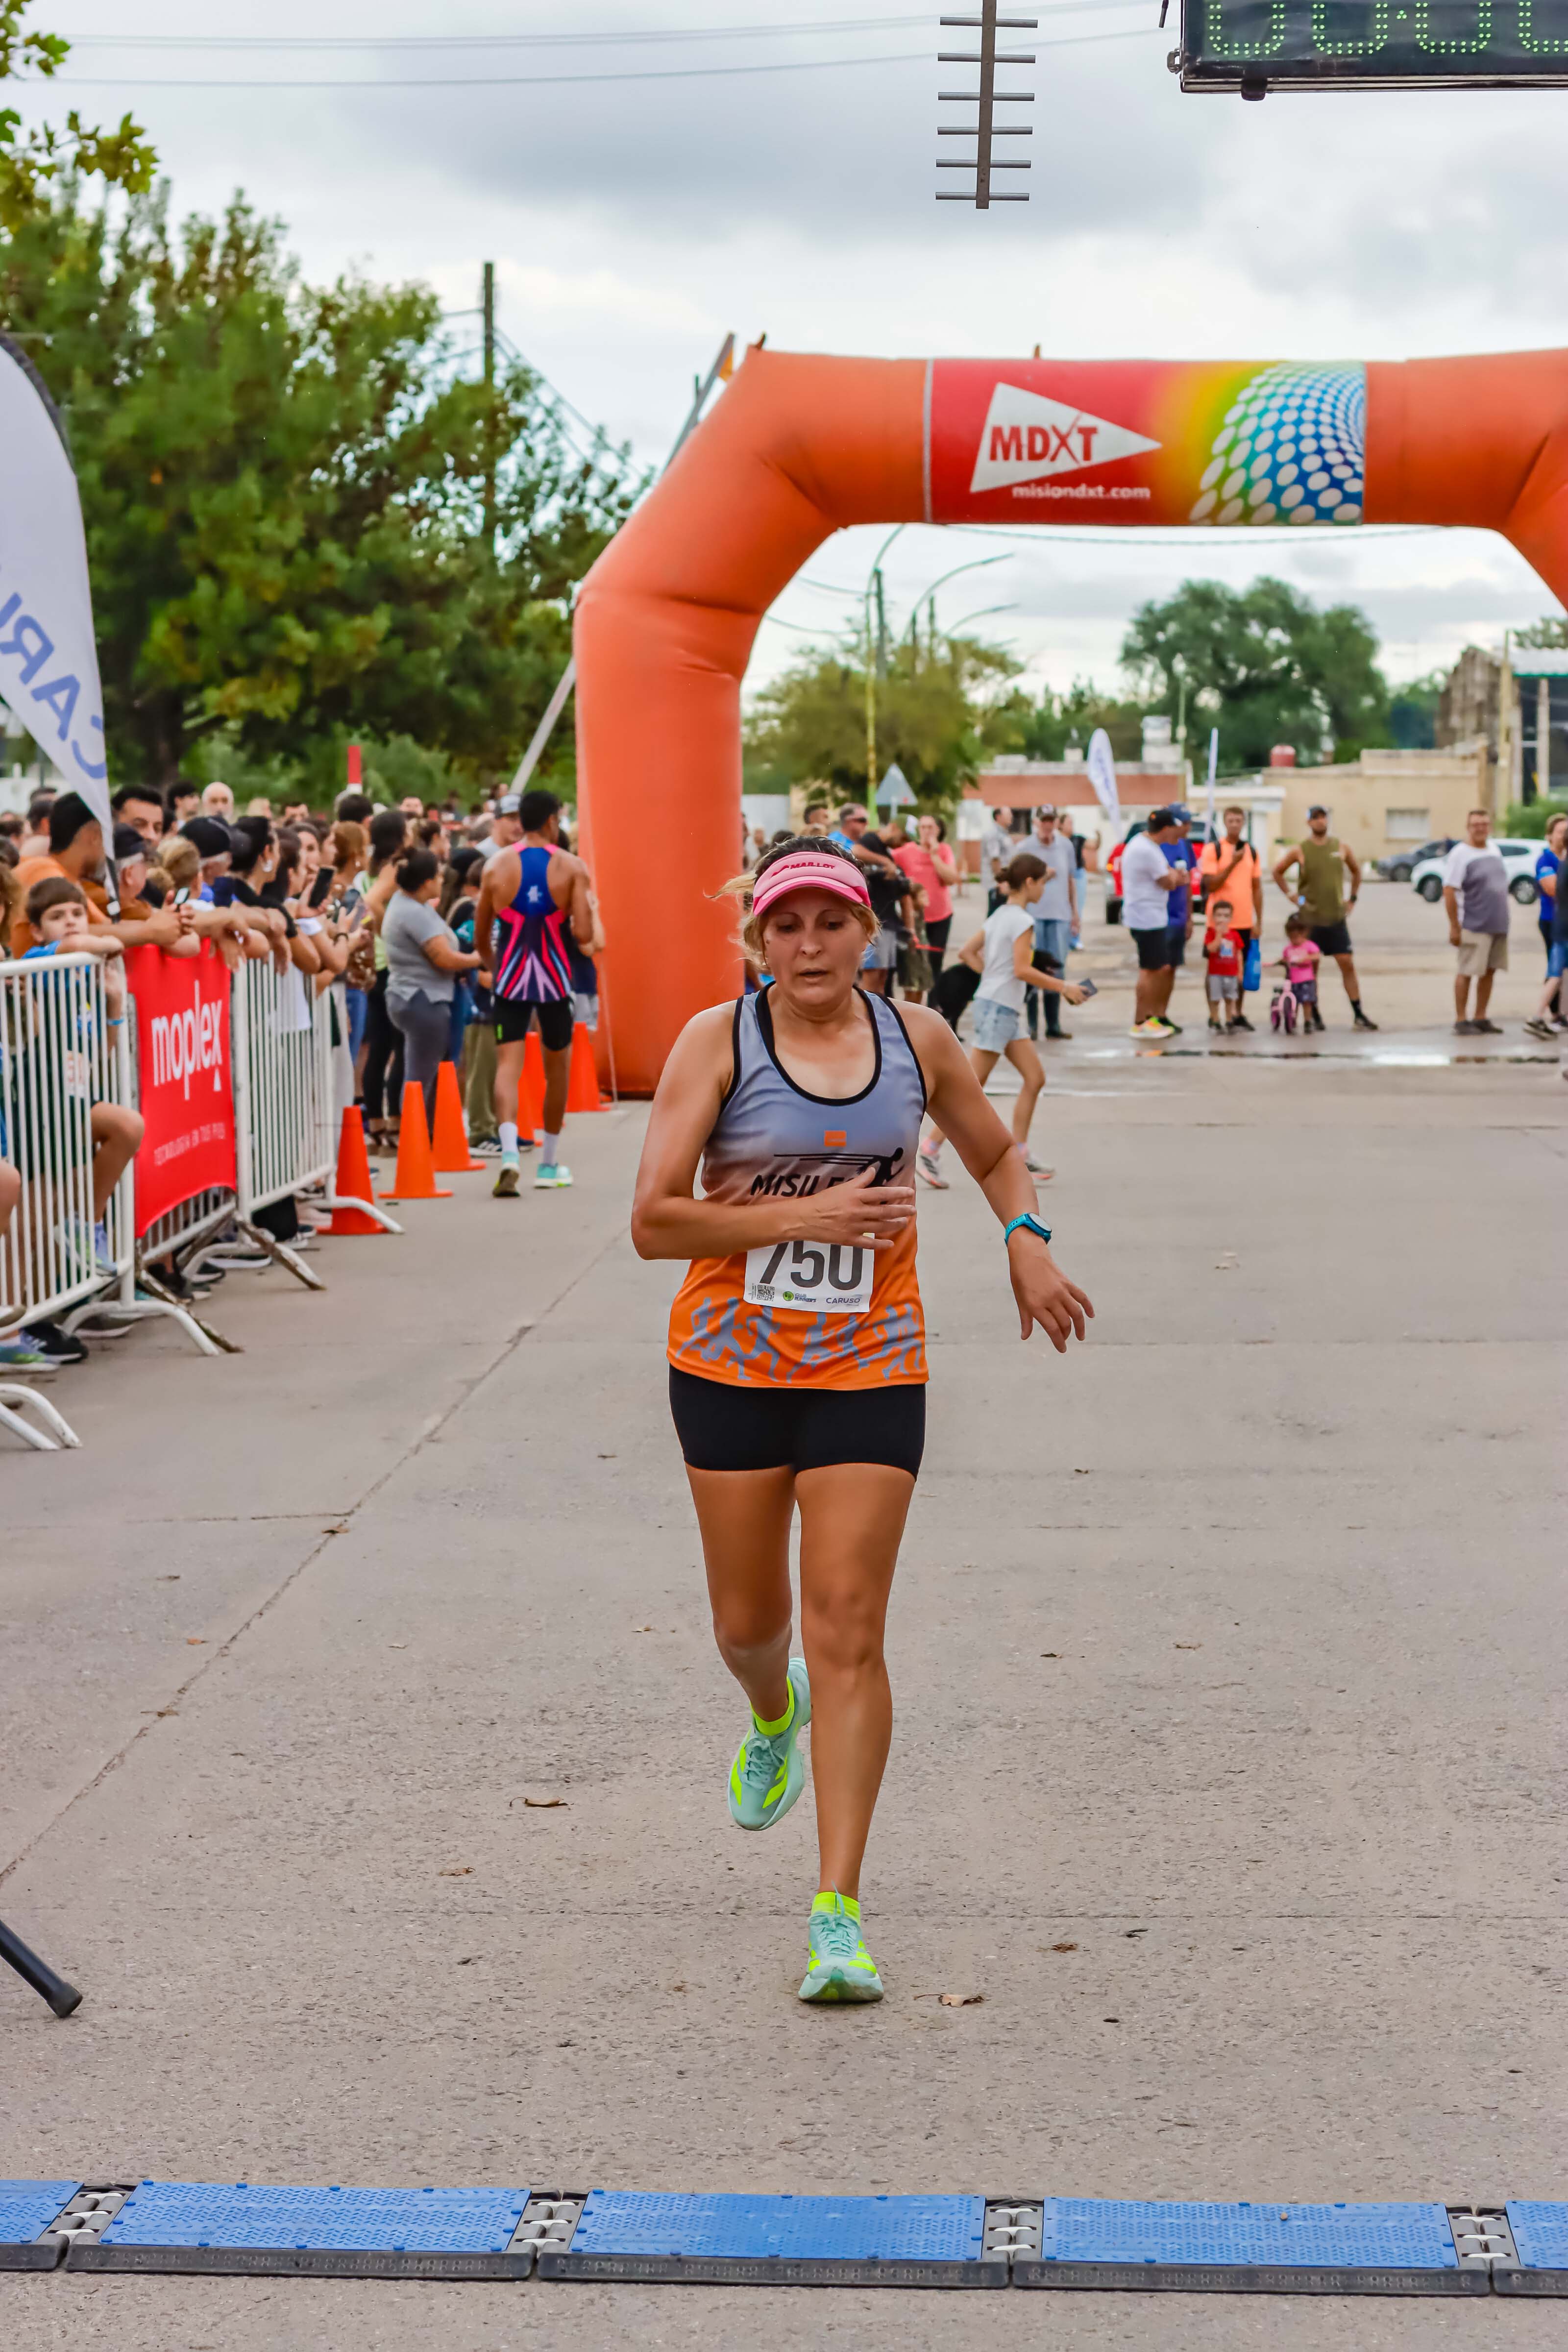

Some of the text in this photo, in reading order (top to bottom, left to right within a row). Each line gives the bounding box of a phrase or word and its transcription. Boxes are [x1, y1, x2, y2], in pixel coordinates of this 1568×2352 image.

[989, 423, 1098, 464] MDXT
[1012, 483, 1150, 499] misiondxt.com
[152, 980, 222, 1101] moplex
